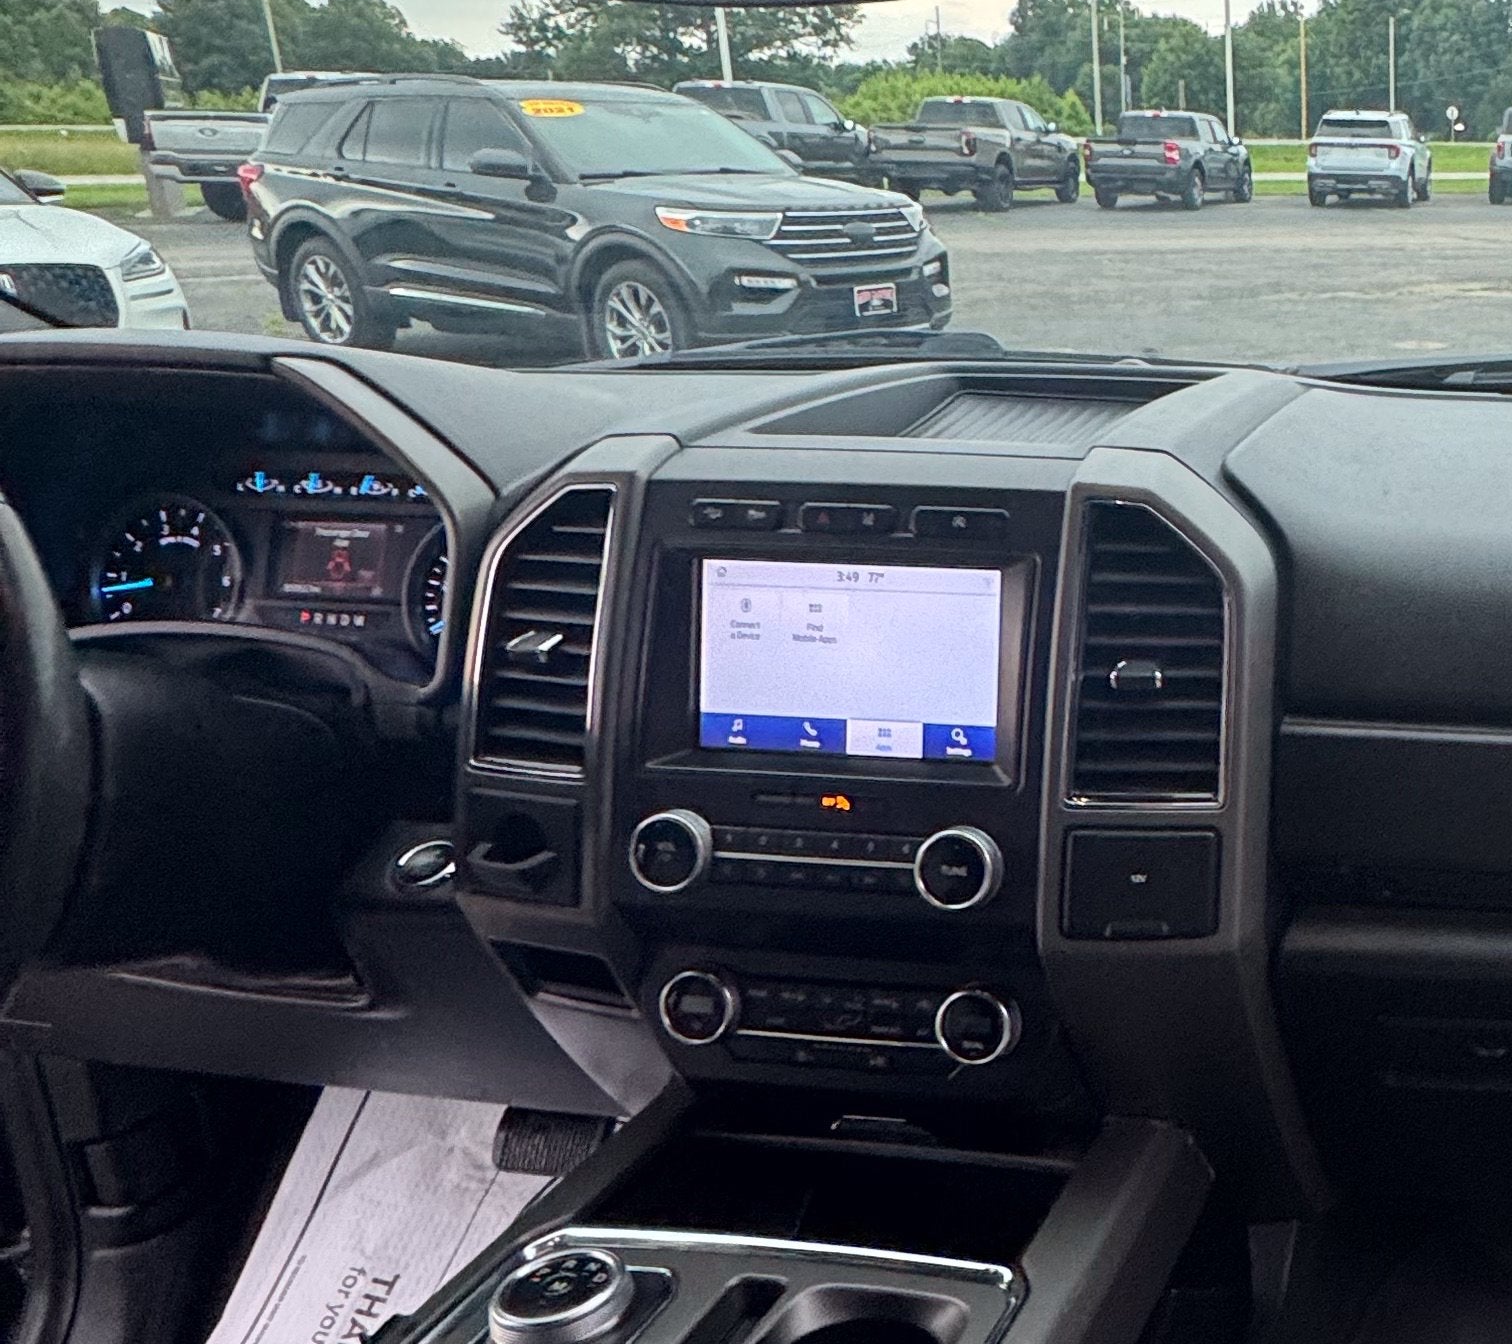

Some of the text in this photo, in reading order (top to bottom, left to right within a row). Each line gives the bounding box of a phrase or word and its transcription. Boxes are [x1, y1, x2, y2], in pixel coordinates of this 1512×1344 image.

[836, 570, 860, 583] 3:49
[806, 622, 824, 633] Find
[338, 1266, 367, 1299] for
